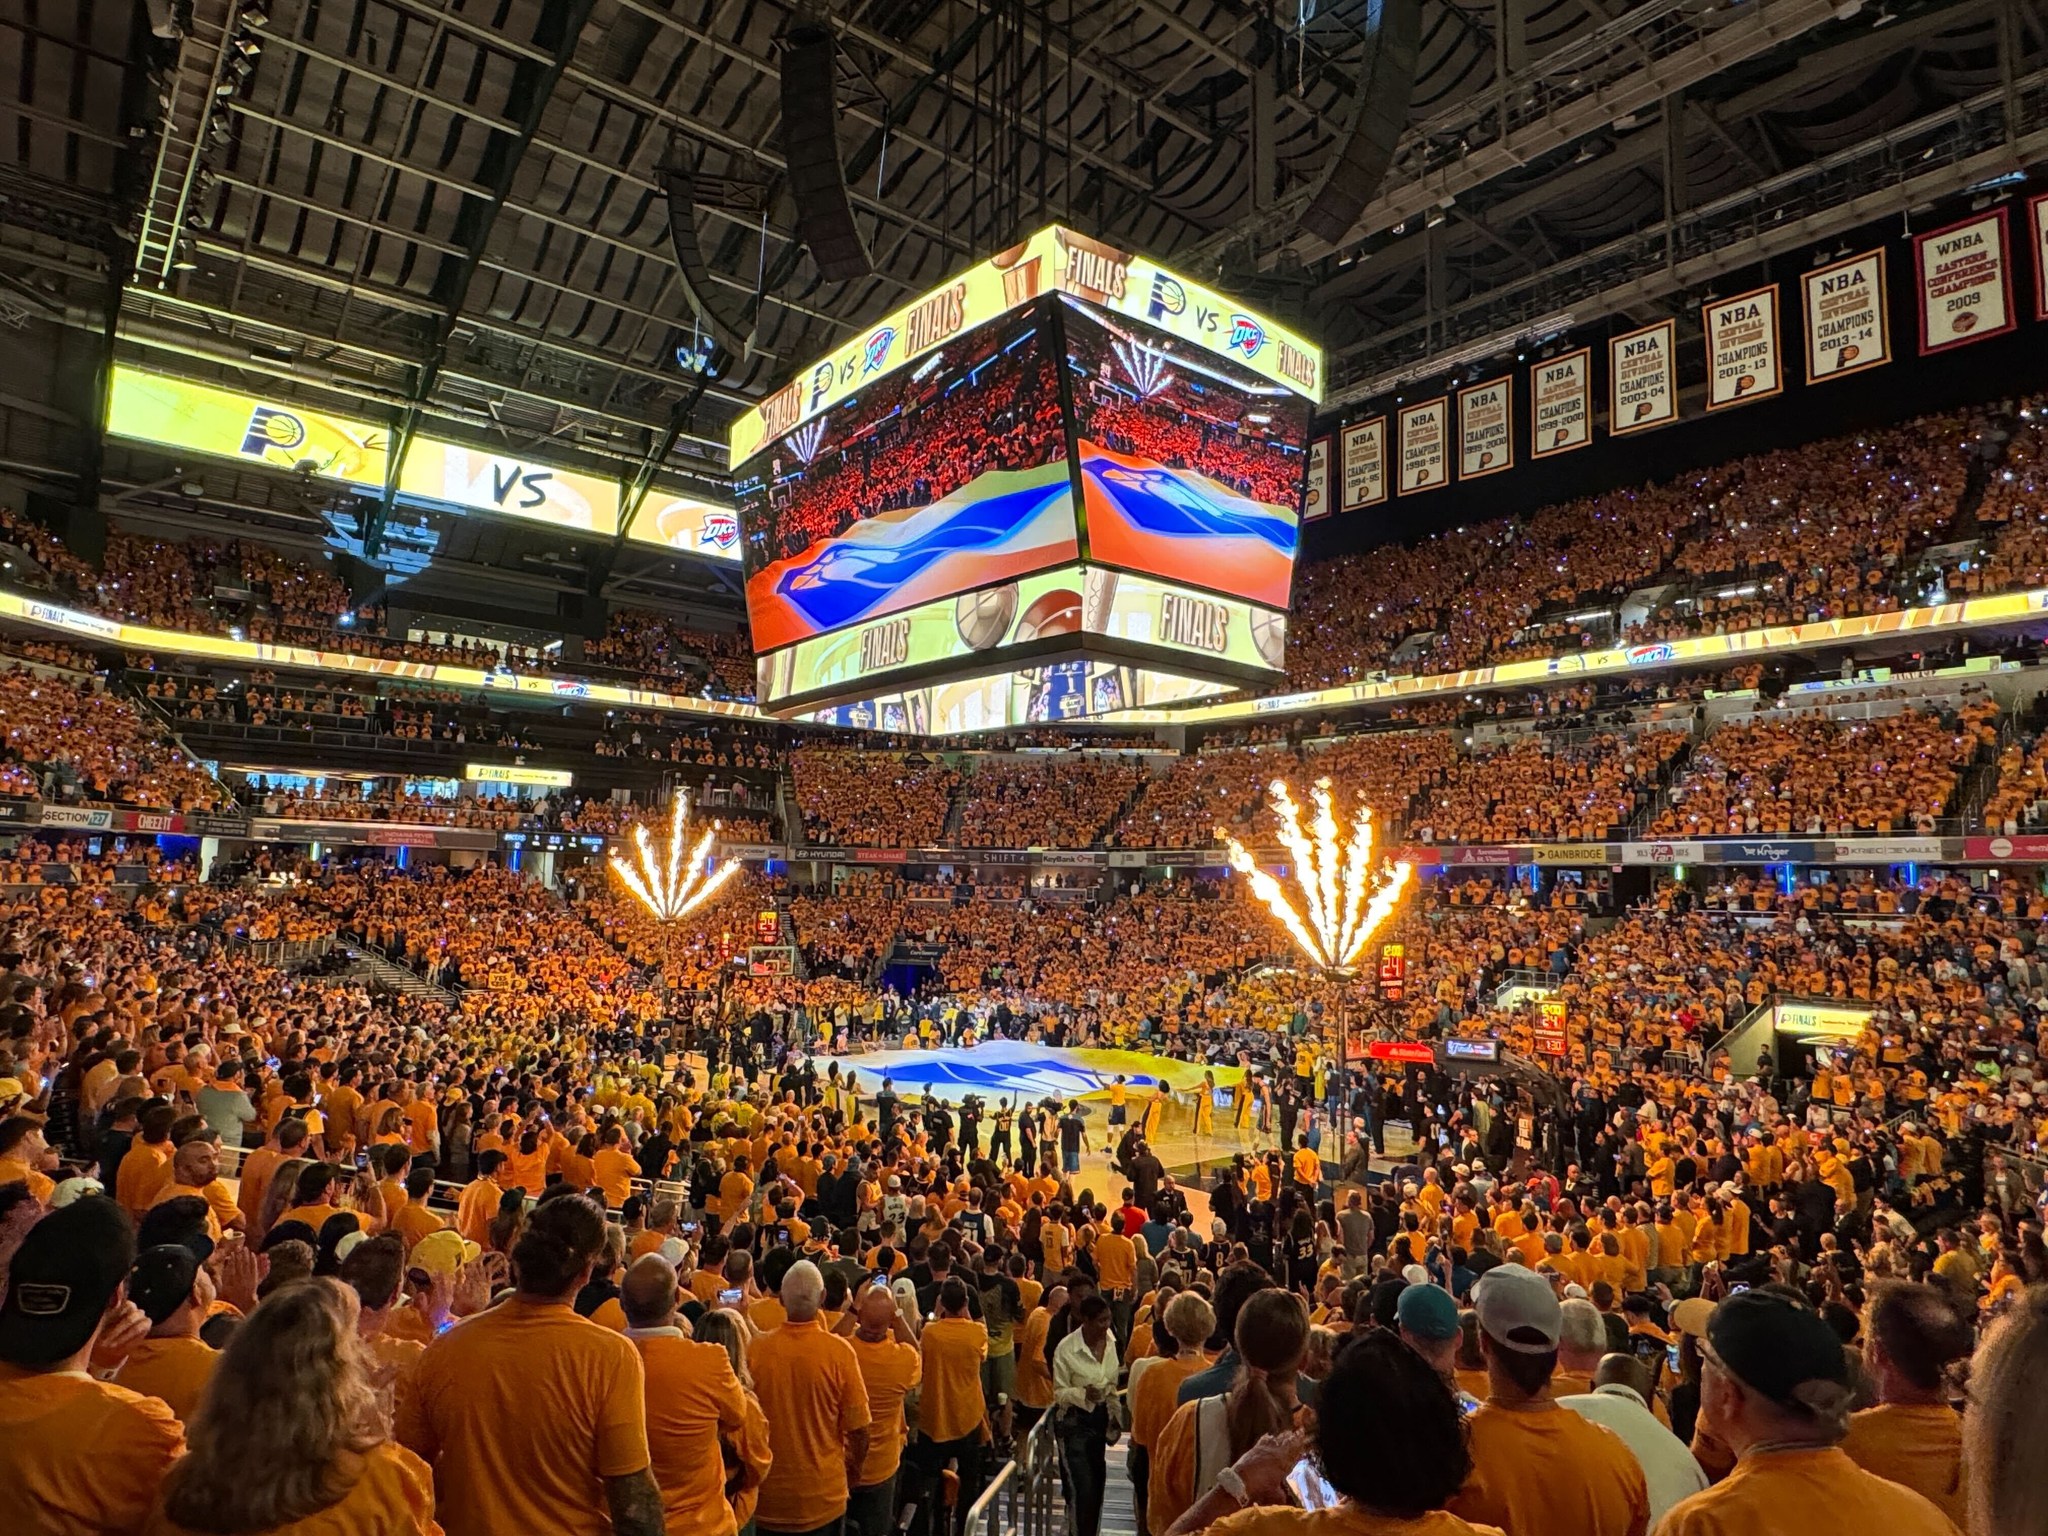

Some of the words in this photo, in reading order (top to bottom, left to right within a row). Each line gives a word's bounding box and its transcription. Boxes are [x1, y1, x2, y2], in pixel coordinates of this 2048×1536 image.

[1937, 232, 1983, 256] WNBA
[1065, 245, 1125, 300] FINALS
[1936, 250, 1987, 274] EASTERN
[1821, 270, 1866, 296] NBA
[1931, 271, 1995, 298] CHAMPIONS
[1947, 292, 1980, 312] 2009
[904, 282, 966, 358] FINALS
[1196, 305, 1220, 332] VS
[1720, 304, 1760, 326] NBA
[1818, 310, 1873, 339] CHAMPIONS
[1624, 337, 1658, 358] NBA
[1717, 342, 1767, 366] CHAMPIONS
[1277, 340, 1315, 388] FINALS
[1546, 365, 1574, 383] NBA
[1620, 371, 1664, 394] CHAMPIONS
[1470, 391, 1498, 409] NBA
[1621, 386, 1664, 405] 2003-04
[763, 380, 802, 442] FINALS
[1540, 398, 1581, 420] CHAMPIONS
[1411, 412, 1435, 428] NBA
[1352, 431, 1374, 447] NBA
[1466, 423, 1504, 443] CHAMPIONS
[493, 463, 553, 509] VS
[1158, 592, 1228, 652] FINALS
[859, 617, 909, 673] FINALS
[44, 810, 89, 822] SECTION
[983, 854, 1015, 862] SHIFT
[1043, 855, 1076, 863] KeyBank
[1548, 849, 1602, 860] GAINBRIDGE
[1757, 844, 1789, 860] Kroger
[760, 918, 775, 930] 24
[1382, 957, 1399, 977] 24
[1542, 1014, 1558, 1027] 24
[1216, 1252, 1223, 1267] 8
[1298, 1244, 1314, 1259] 33
